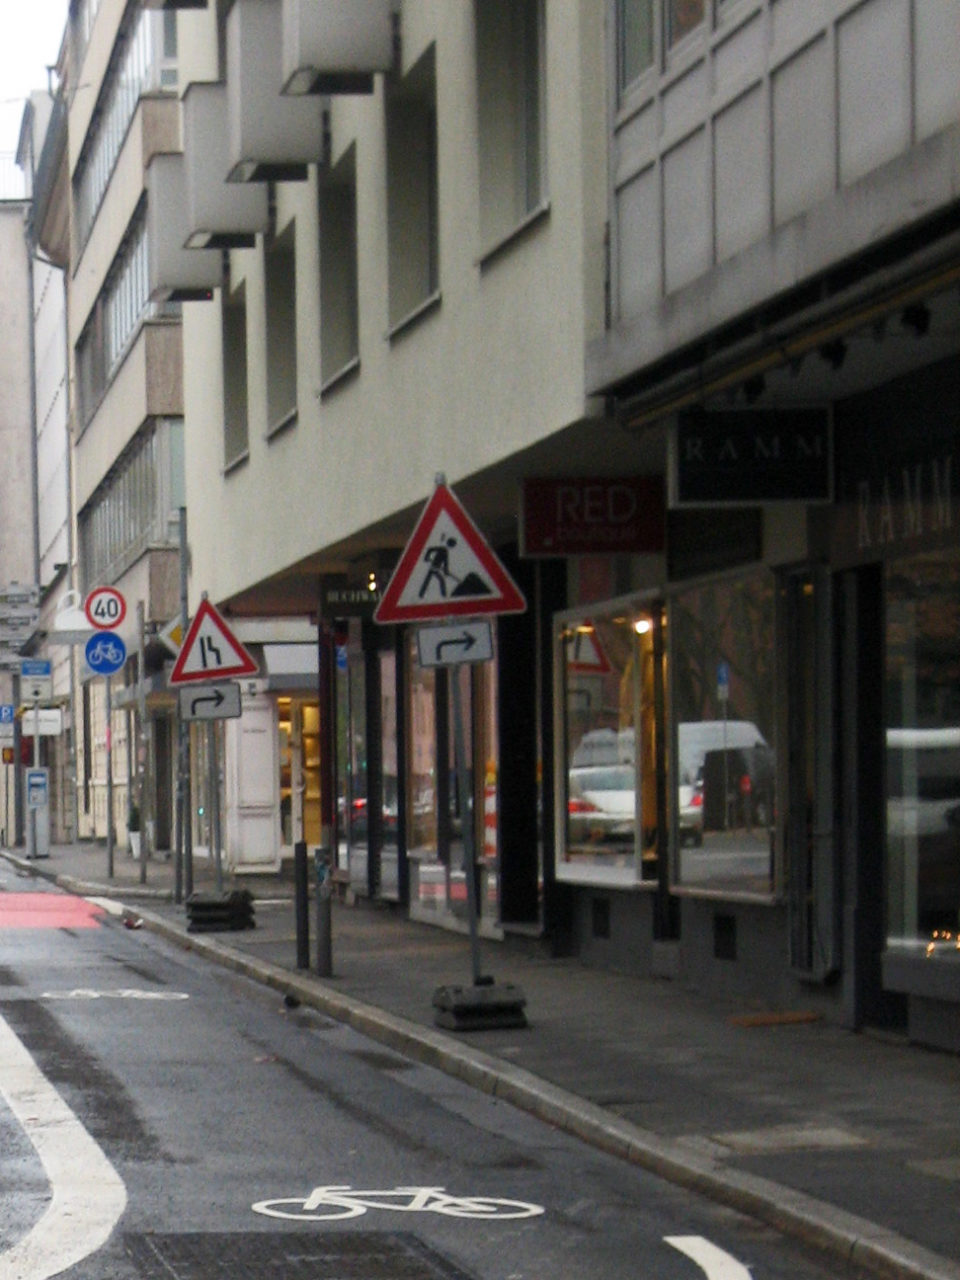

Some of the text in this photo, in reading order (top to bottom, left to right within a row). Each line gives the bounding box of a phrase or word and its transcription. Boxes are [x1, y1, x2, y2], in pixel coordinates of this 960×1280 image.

[686, 434, 823, 460] RAMM
[556, 484, 637, 524] RED
[856, 455, 952, 547] RAMM
[94, 598, 119, 619] 40
